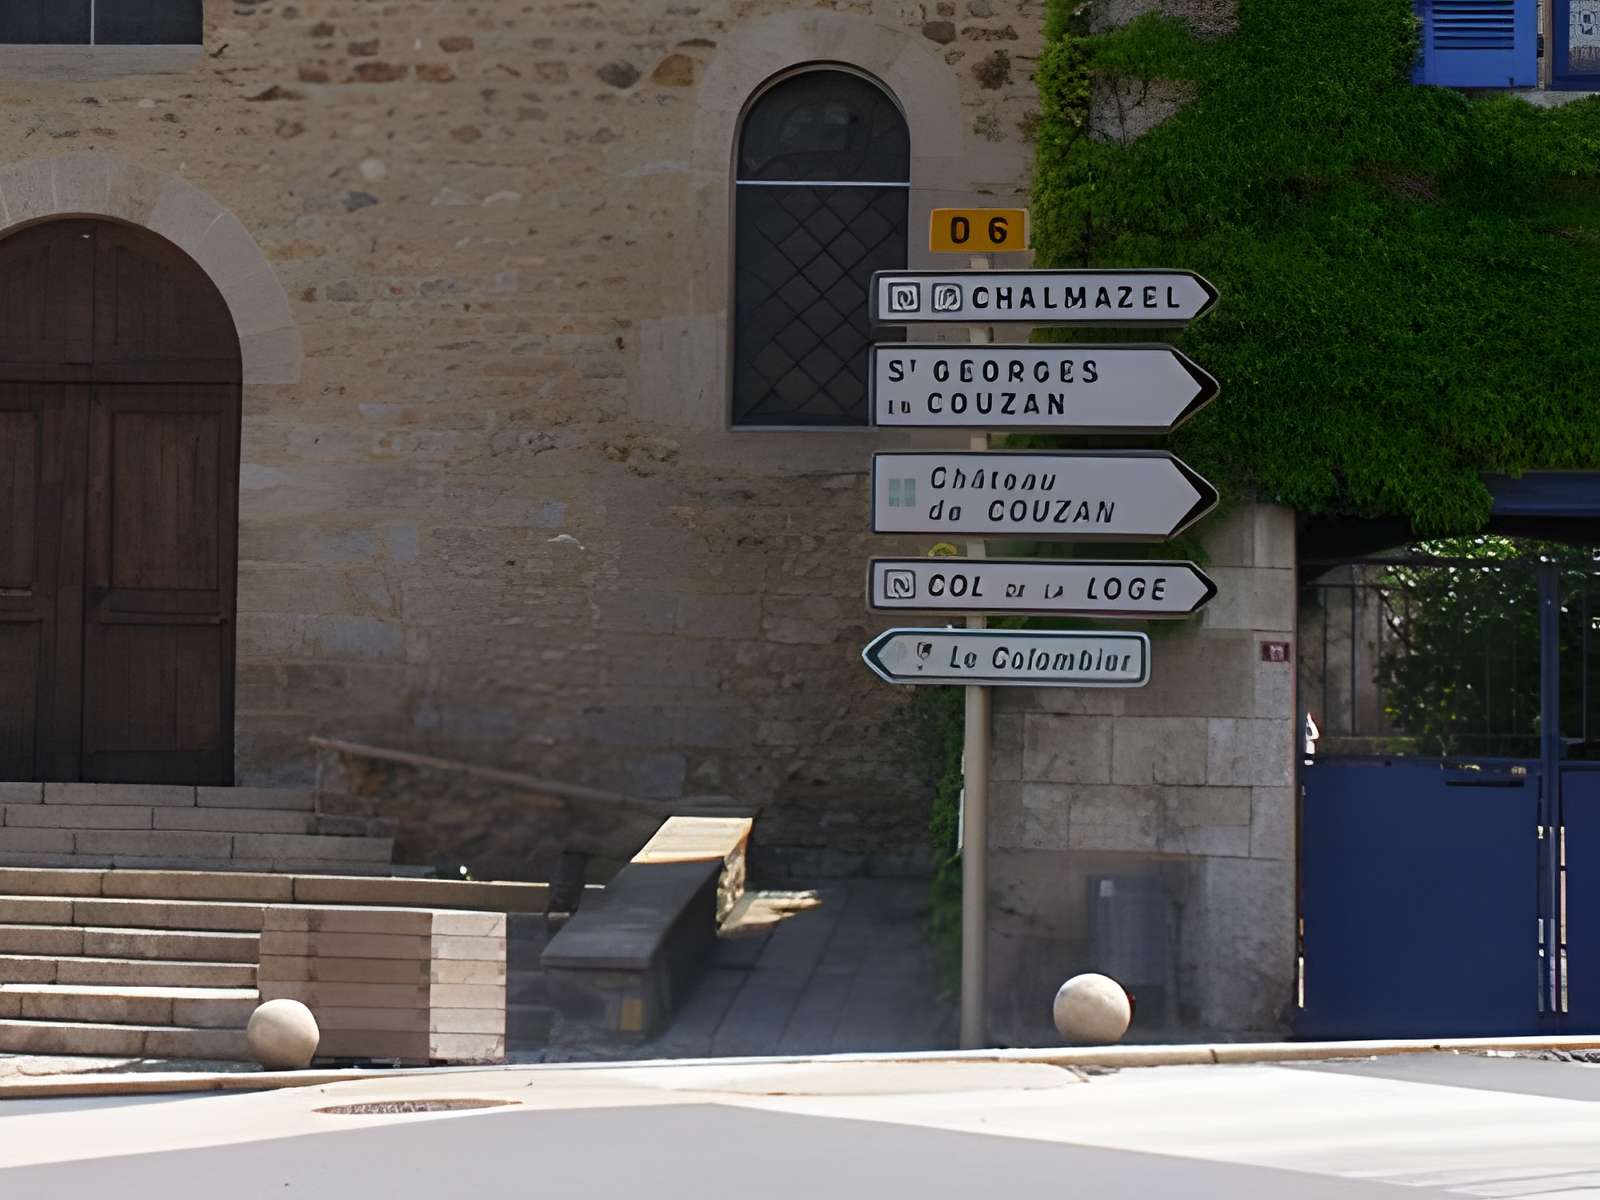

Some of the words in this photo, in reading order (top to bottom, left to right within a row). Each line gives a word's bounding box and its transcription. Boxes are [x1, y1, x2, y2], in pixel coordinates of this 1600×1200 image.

[972, 285, 1180, 310] CHALMAZEL
[933, 359, 1099, 384] GEORGES
[927, 392, 1065, 416] COUZAN
[988, 499, 1115, 524] COUZAN
[928, 573, 984, 598] COL
[1086, 576, 1167, 601] LOGE
[949, 645, 978, 669] Le
